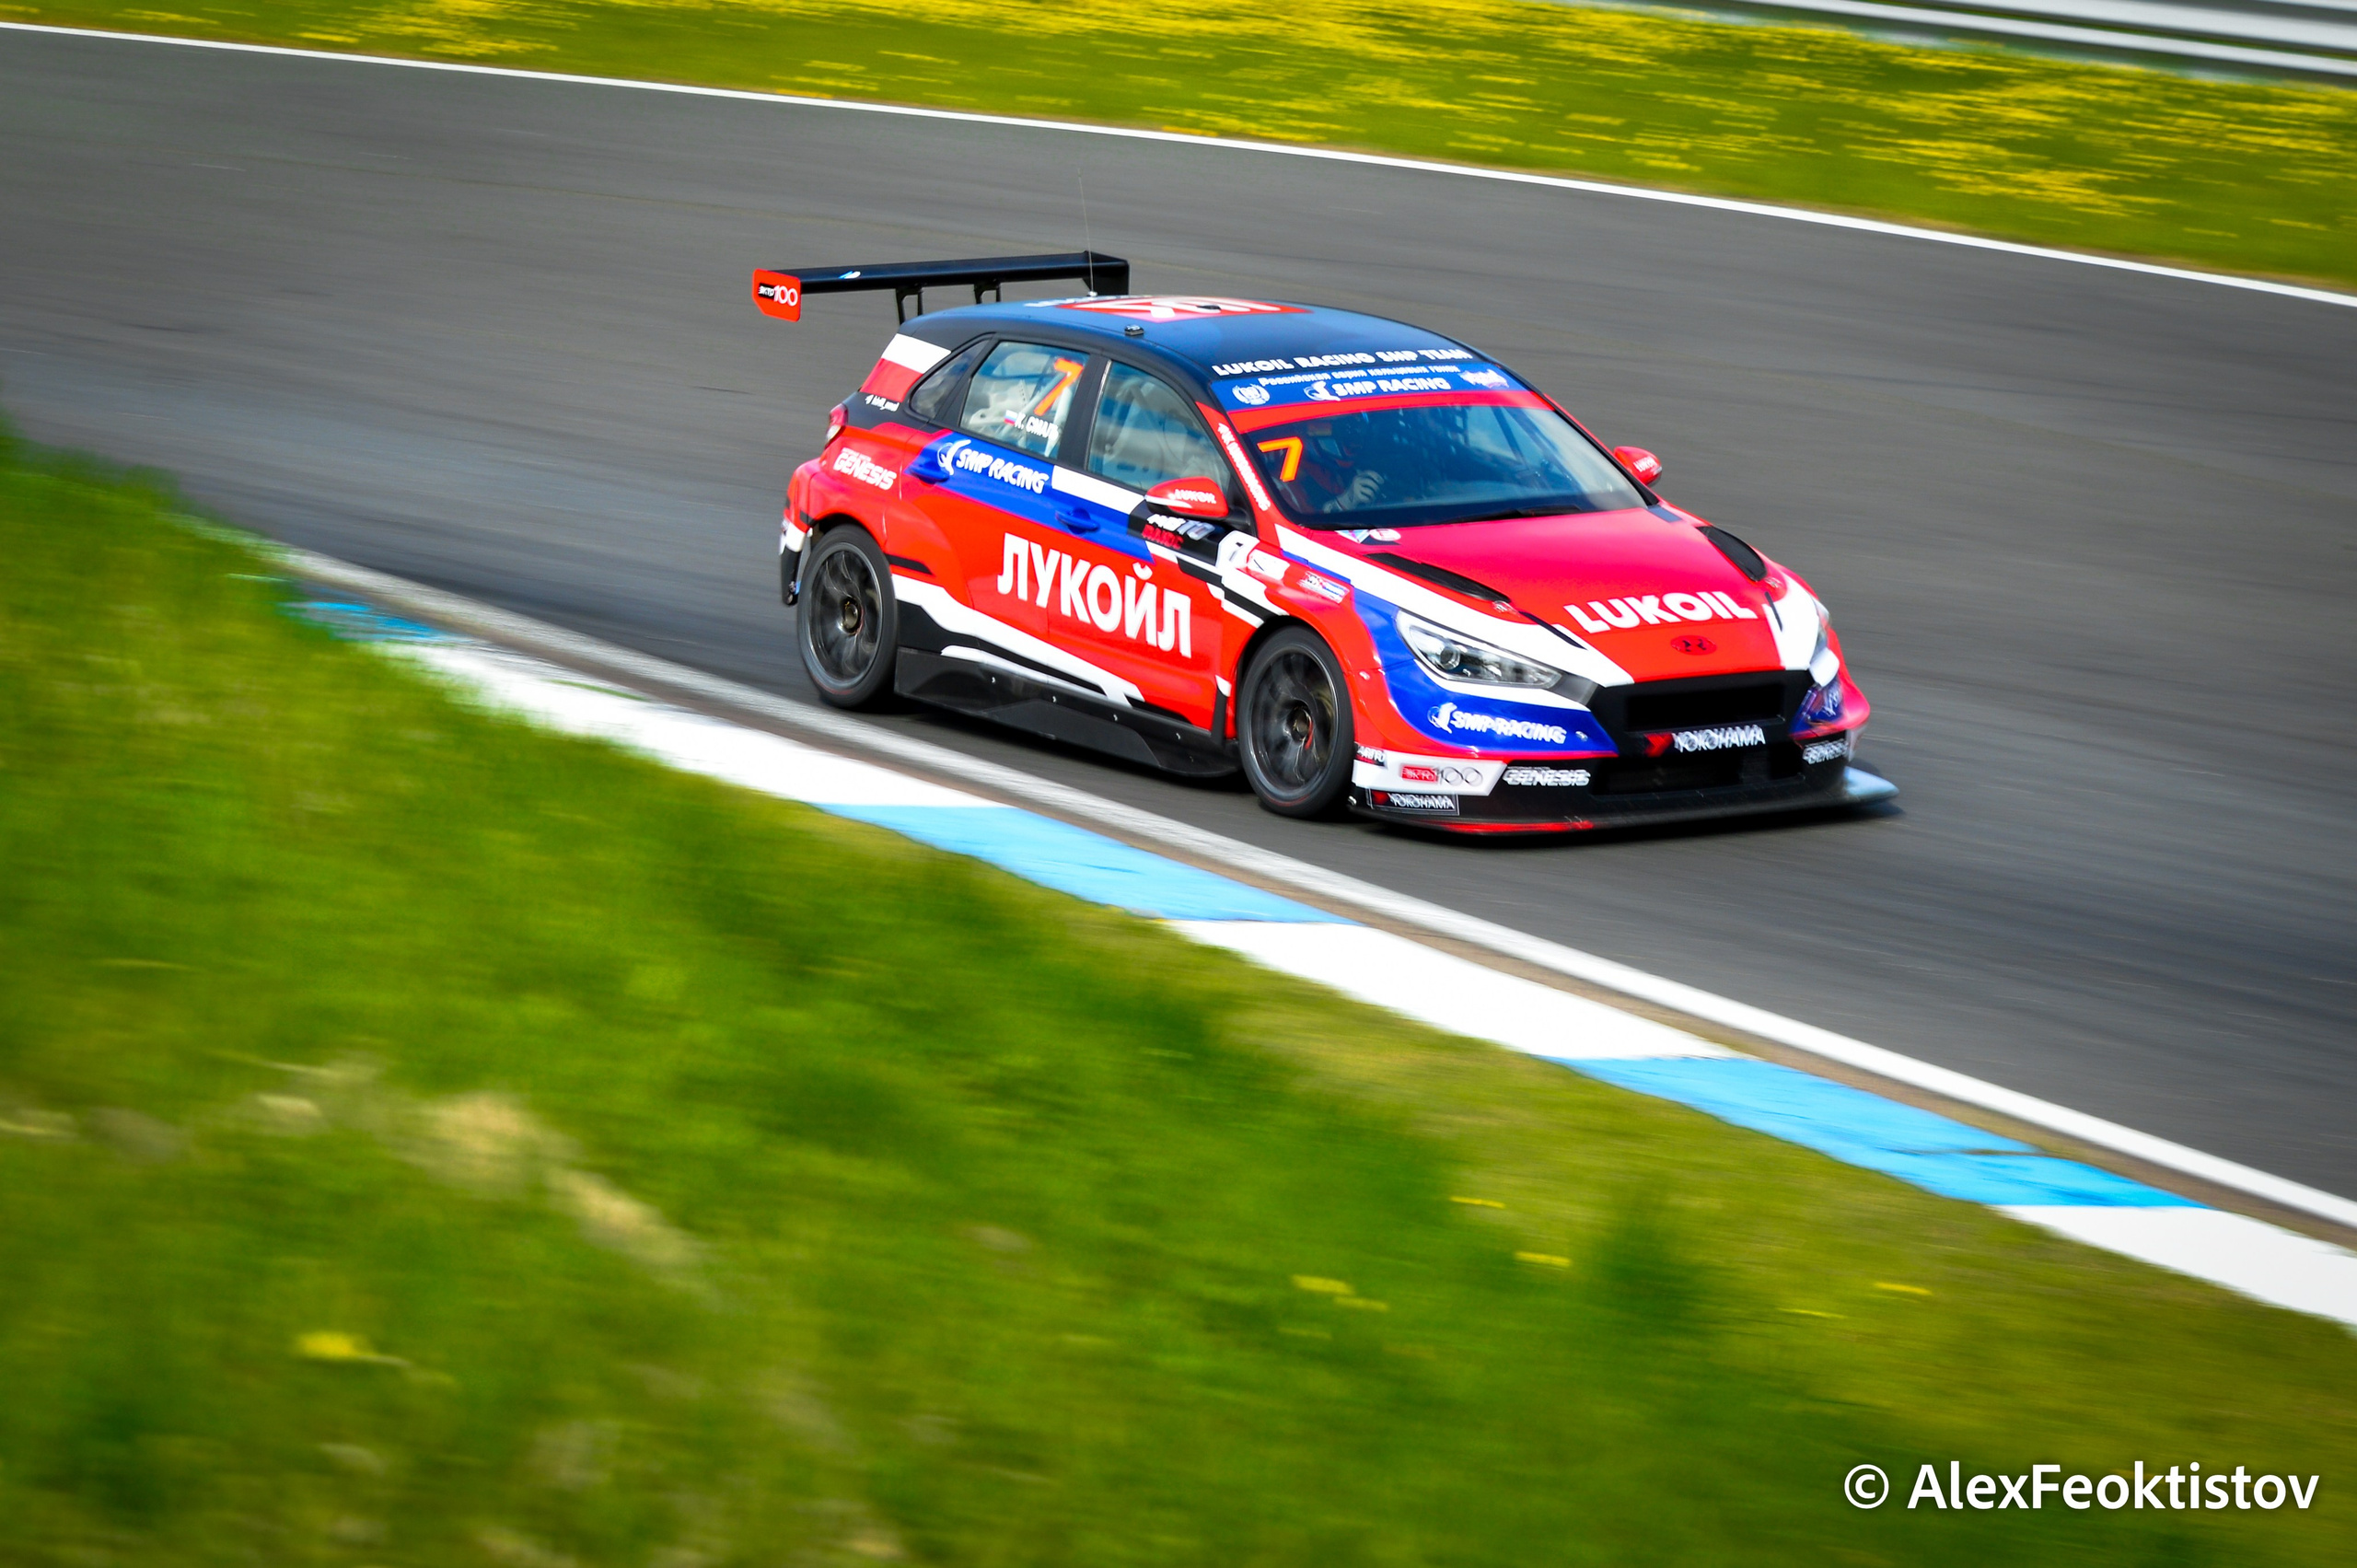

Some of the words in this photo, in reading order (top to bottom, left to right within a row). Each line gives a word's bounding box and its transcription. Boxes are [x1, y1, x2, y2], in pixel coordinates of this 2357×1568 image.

[773, 285, 798, 307] 100
[1212, 358, 1295, 376] LUKOIL
[1294, 352, 1376, 368] RACING
[1376, 350, 1419, 362] SMP
[1418, 349, 1473, 360] TEAM
[1033, 357, 1085, 417] 7
[1258, 372, 1331, 387] Российская
[1331, 381, 1377, 398] SMP
[1376, 377, 1452, 393] RACING
[832, 452, 898, 491] GENESIS
[956, 448, 993, 474] SMP
[988, 458, 1050, 494] RACING
[1256, 436, 1303, 482] 7
[997, 531, 1192, 659] ЛУКОЙЛ
[1562, 591, 1759, 633] LUKOIL
[1450, 710, 1495, 734] SMP
[1492, 716, 1567, 744] RACING
[1671, 724, 1766, 753] YOKOHAMA
[1436, 766, 1484, 786] 100
[1503, 768, 1591, 787] GENESIS
[1387, 793, 1456, 810] YOKOHAMA
